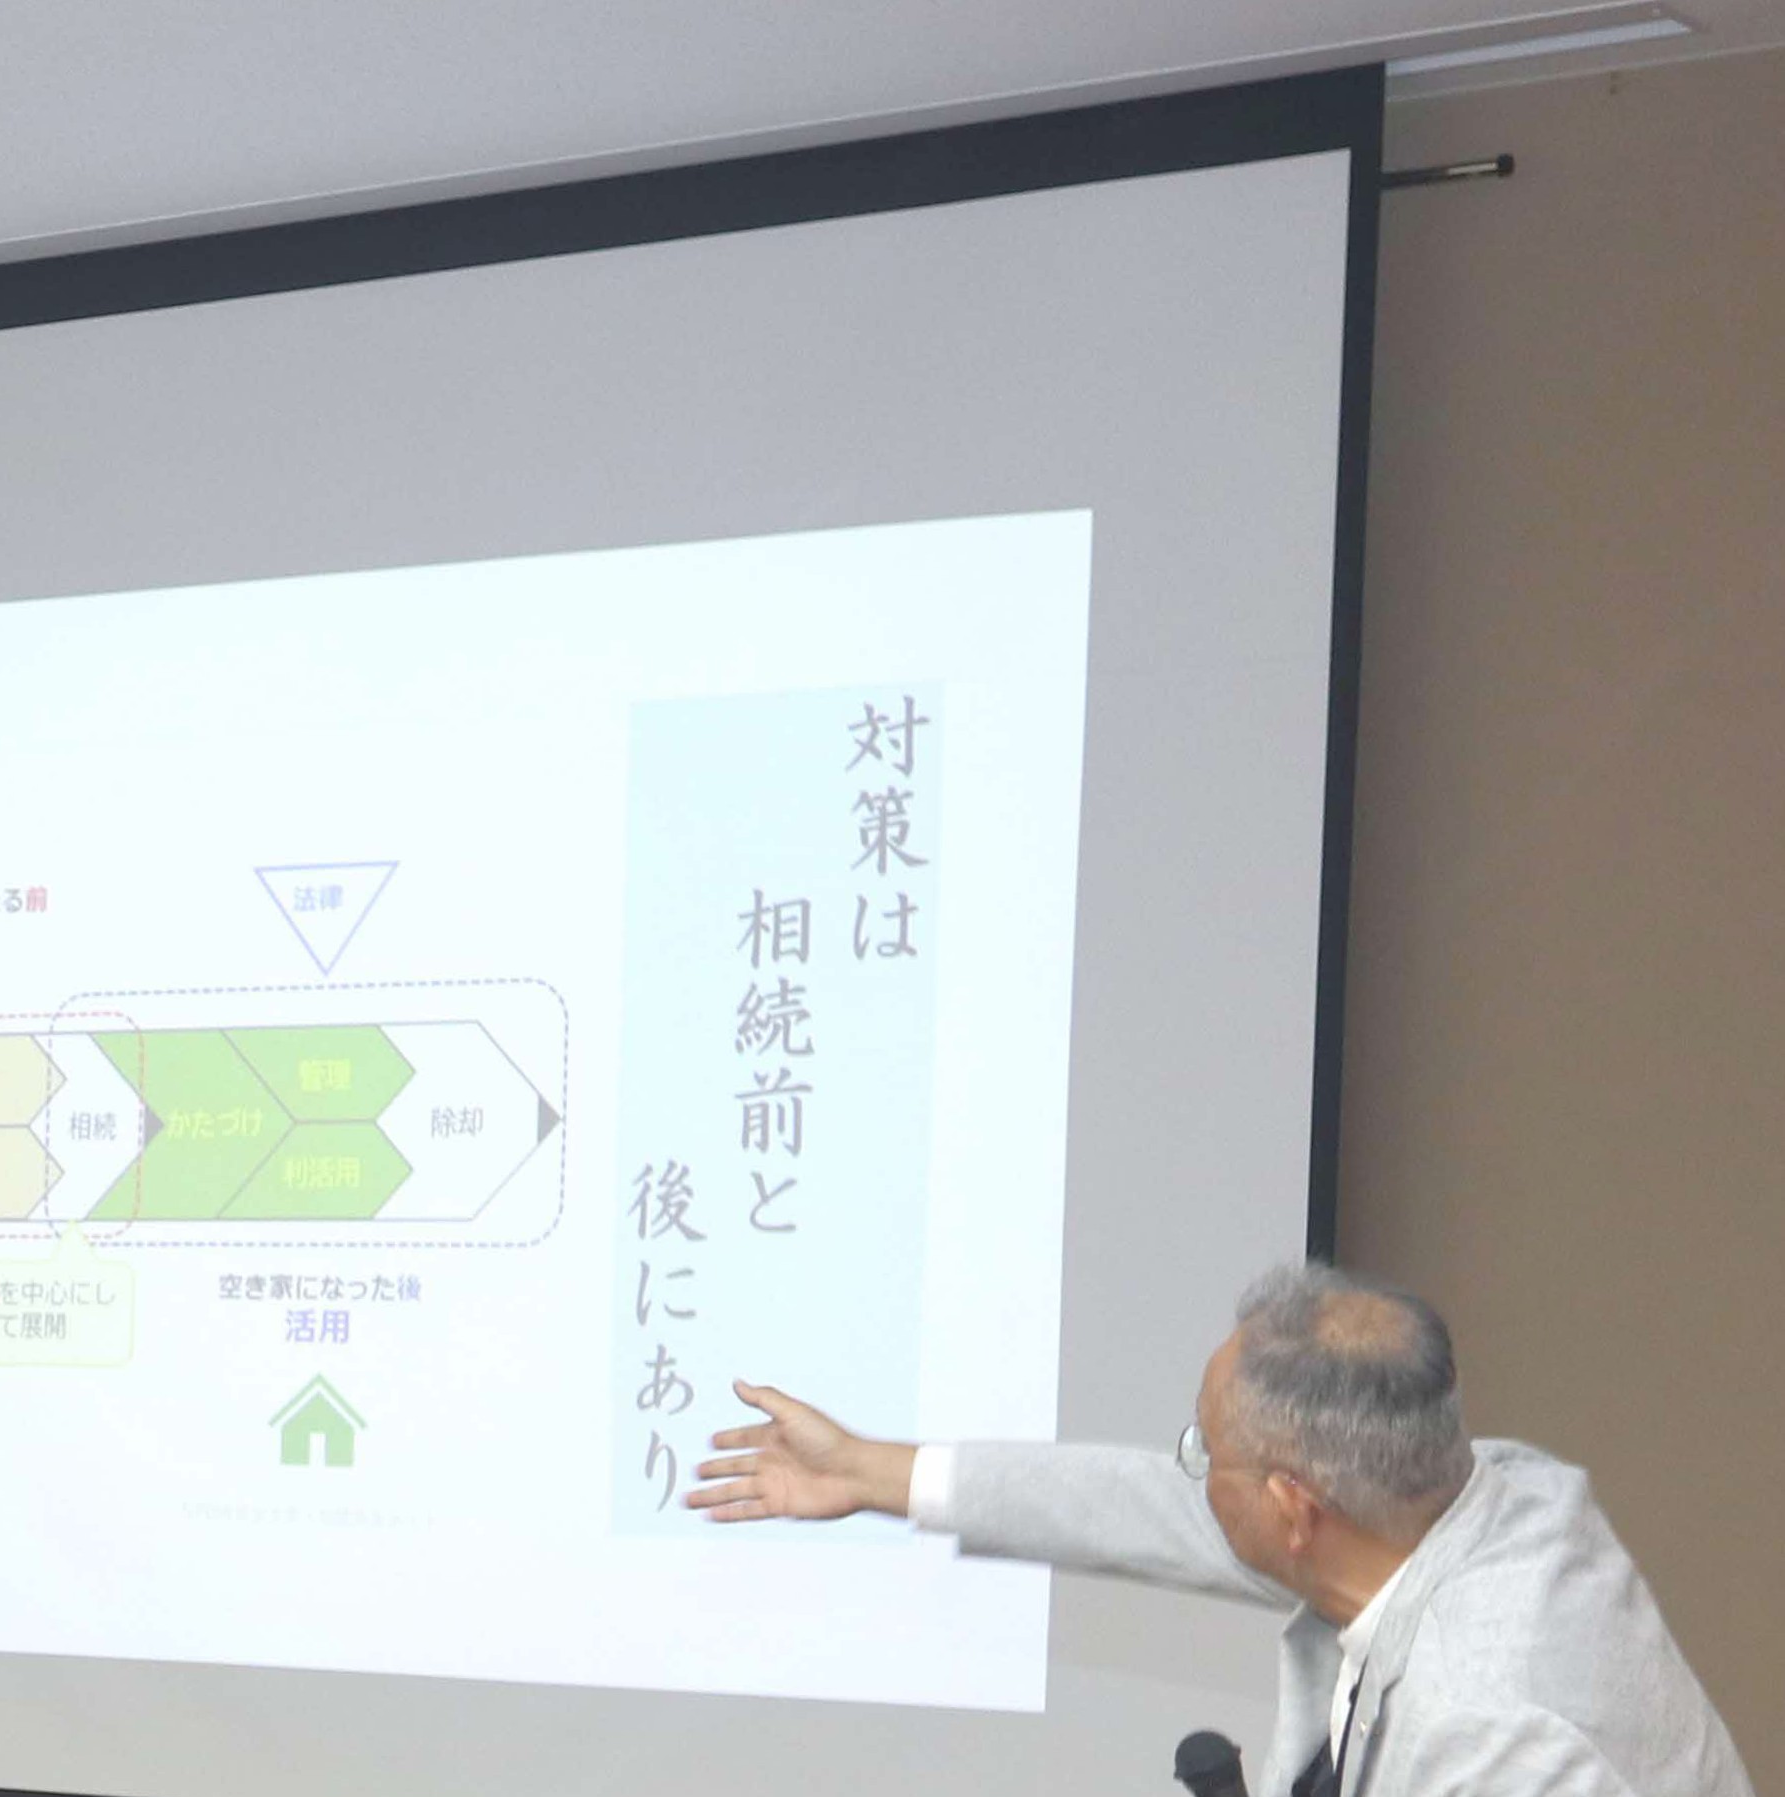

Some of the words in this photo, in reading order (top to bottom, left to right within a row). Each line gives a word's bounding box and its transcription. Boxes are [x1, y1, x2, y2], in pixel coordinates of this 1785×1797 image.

[845, 694, 931, 961] 対策は
[293, 885, 344, 912] 法律
[734, 889, 814, 1234] 相続前と
[69, 1111, 117, 1143] 相続
[167, 1107, 264, 1138] かたづけ
[430, 1106, 484, 1138] 除却
[219, 1273, 422, 1304] 空き家になった後
[0, 1312, 67, 1341] て展開
[285, 1310, 350, 1344] 活用
[629, 1158, 707, 1513] 後にあり
